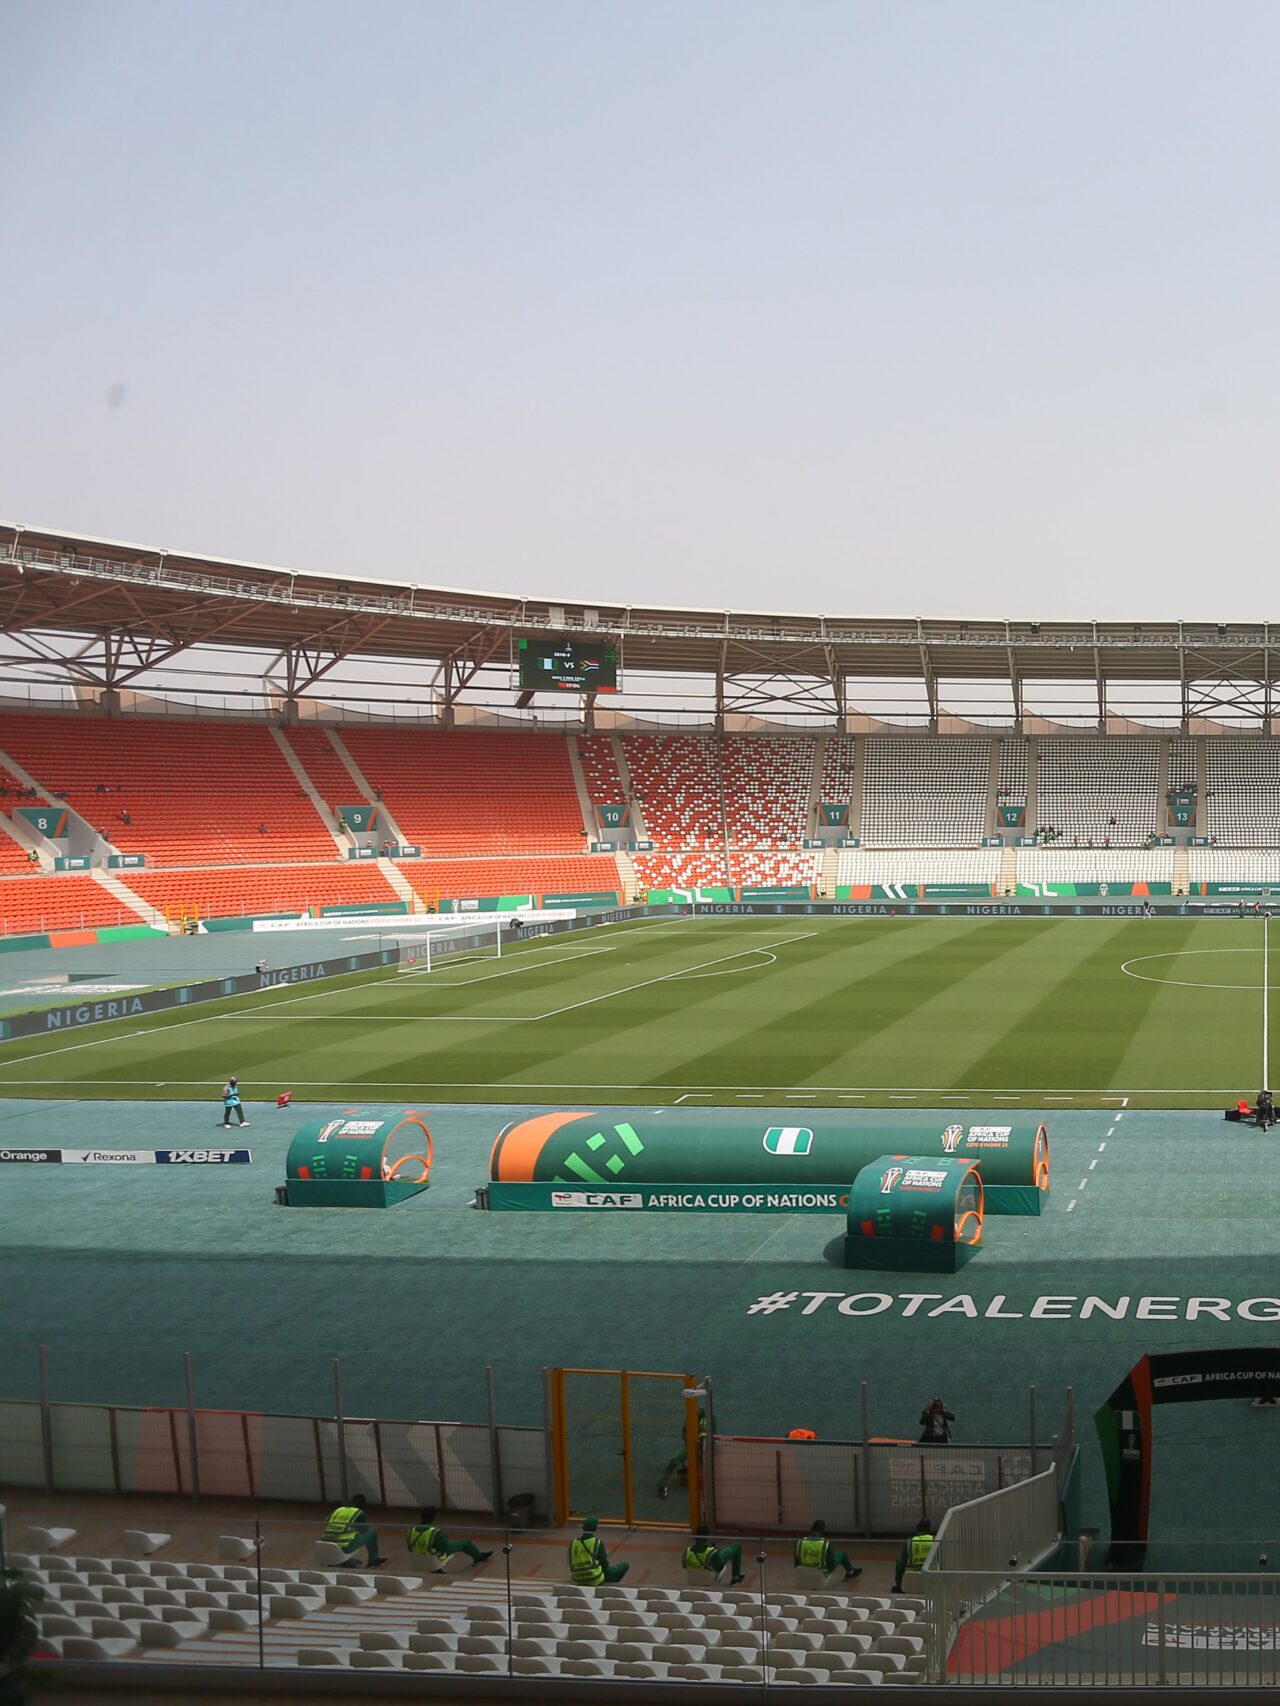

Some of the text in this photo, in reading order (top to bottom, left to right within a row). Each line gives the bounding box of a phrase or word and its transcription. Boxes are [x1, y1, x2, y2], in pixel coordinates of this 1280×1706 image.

[563, 661, 575, 669] VS
[353, 813, 362, 824] 9
[605, 812, 619, 822] 10
[829, 811, 841, 821] 11
[1005, 812, 1018, 822] 12
[1176, 812, 1188, 822] 13
[37, 818, 48, 830] 8
[701, 904, 754, 914] NIGERIA
[833, 905, 887, 915] NIGERIA
[966, 905, 1022, 915] NIGERIA
[1102, 906, 1157, 915] NIGERA
[601, 911, 631, 923] NIGERIA
[517, 923, 555, 939] NIGERIA
[407, 942, 456, 959] NIGERIA
[259, 963, 326, 988] NIGERIA
[47, 997, 144, 1030] NIGERIA
[0, 1150, 48, 1163] Orange
[93, 1152, 136, 1162] Rexona
[168, 1151, 235, 1163] 1XBET
[586, 1194, 633, 1206] CAF
[648, 1193, 705, 1208] AFRICA
[707, 1194, 740, 1208] CUP
[742, 1194, 764, 1208] OF
[767, 1194, 838, 1208] NATIONS
[1172, 1375, 1197, 1385] CAF
[1204, 1372, 1236, 1382] AFRICA
[1236, 1371, 1254, 1380] CUP
[1254, 1371, 1267, 1380] OF
